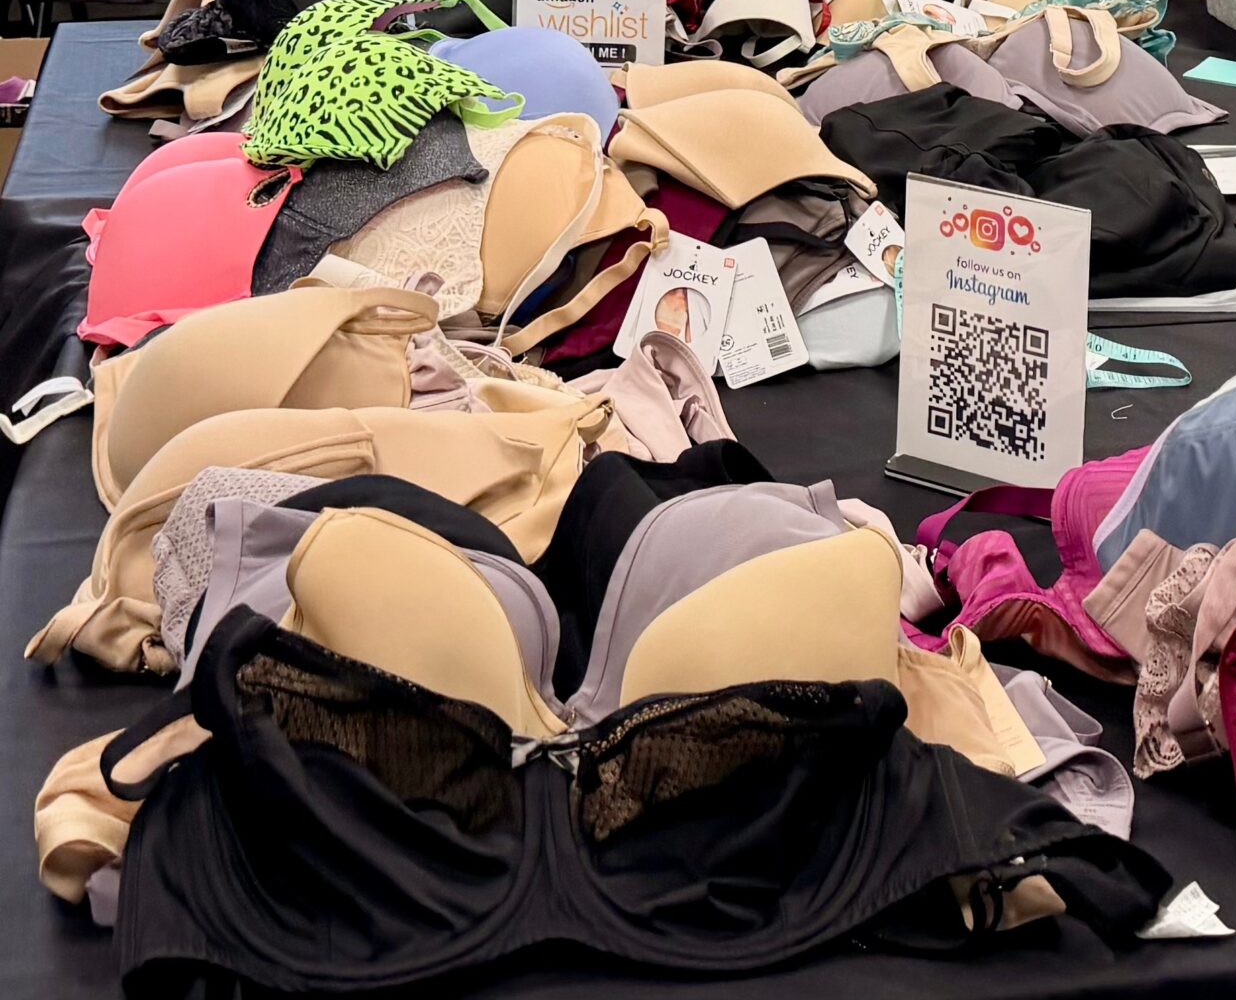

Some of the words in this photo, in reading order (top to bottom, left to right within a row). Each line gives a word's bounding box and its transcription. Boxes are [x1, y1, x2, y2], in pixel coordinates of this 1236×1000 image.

[538, 8, 648, 39] wishlist
[599, 47, 618, 59] ME
[867, 225, 891, 257] JOCKEY
[663, 266, 718, 286] JOCKEY
[956, 255, 990, 275] follow
[992, 266, 1005, 278] us
[1007, 269, 1021, 281] on
[945, 268, 1031, 306] Instagram
